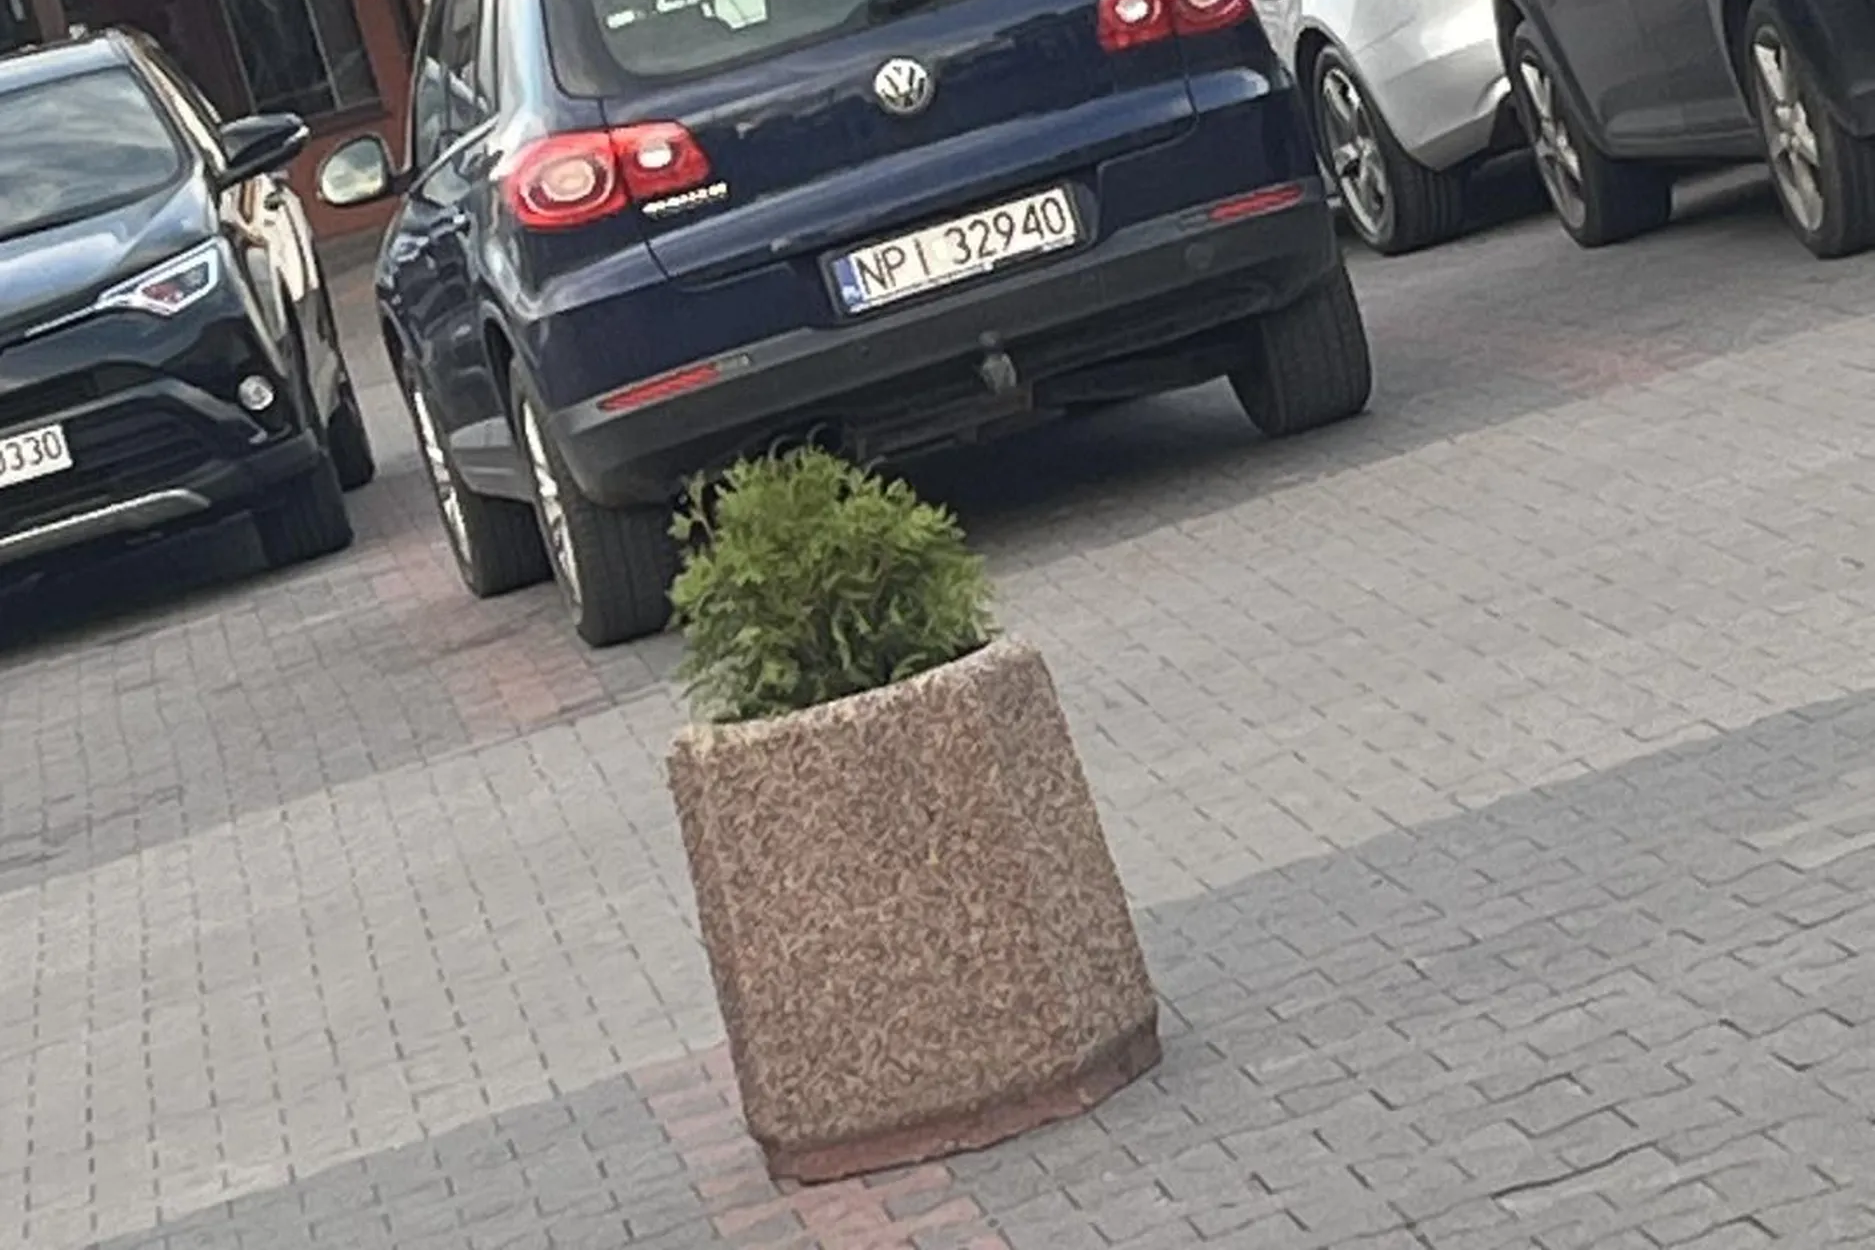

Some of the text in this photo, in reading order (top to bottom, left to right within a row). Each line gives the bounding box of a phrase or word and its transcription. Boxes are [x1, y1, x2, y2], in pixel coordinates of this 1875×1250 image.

[855, 197, 1066, 295] NPI 32940
[0, 431, 62, 476] 330
